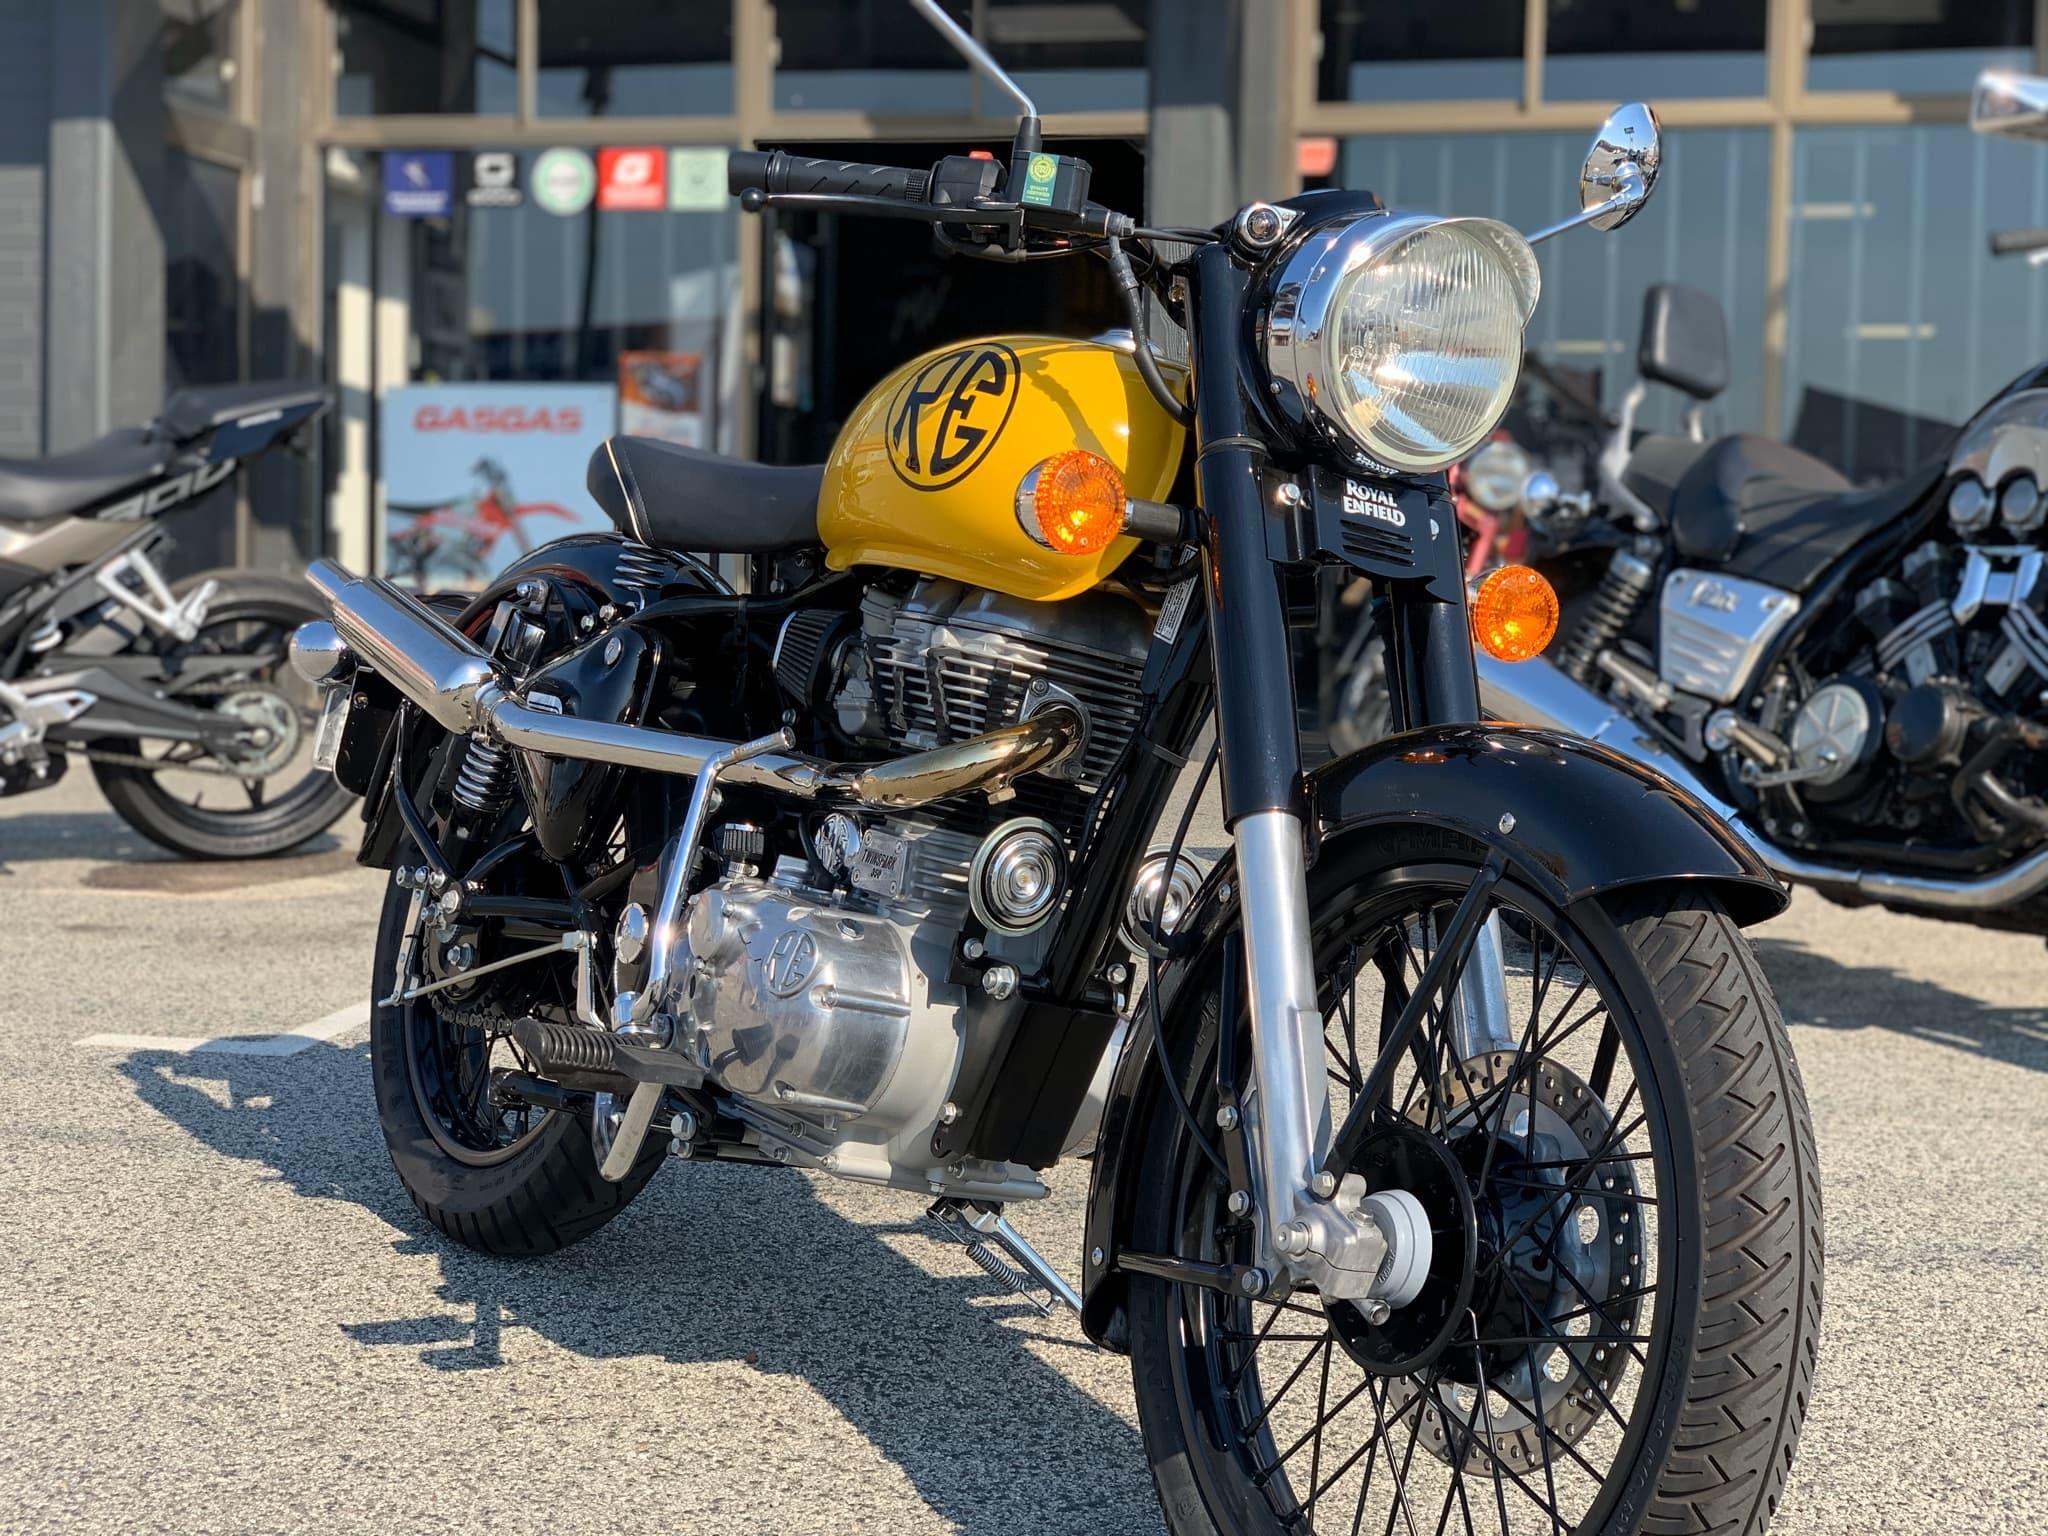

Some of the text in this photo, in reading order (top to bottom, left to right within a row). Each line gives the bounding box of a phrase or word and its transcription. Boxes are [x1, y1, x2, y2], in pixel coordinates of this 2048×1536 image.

[414, 405, 582, 433] GASGAS
[1346, 479, 1398, 508] ROYAL
[1343, 496, 1406, 527] ENFIELD
